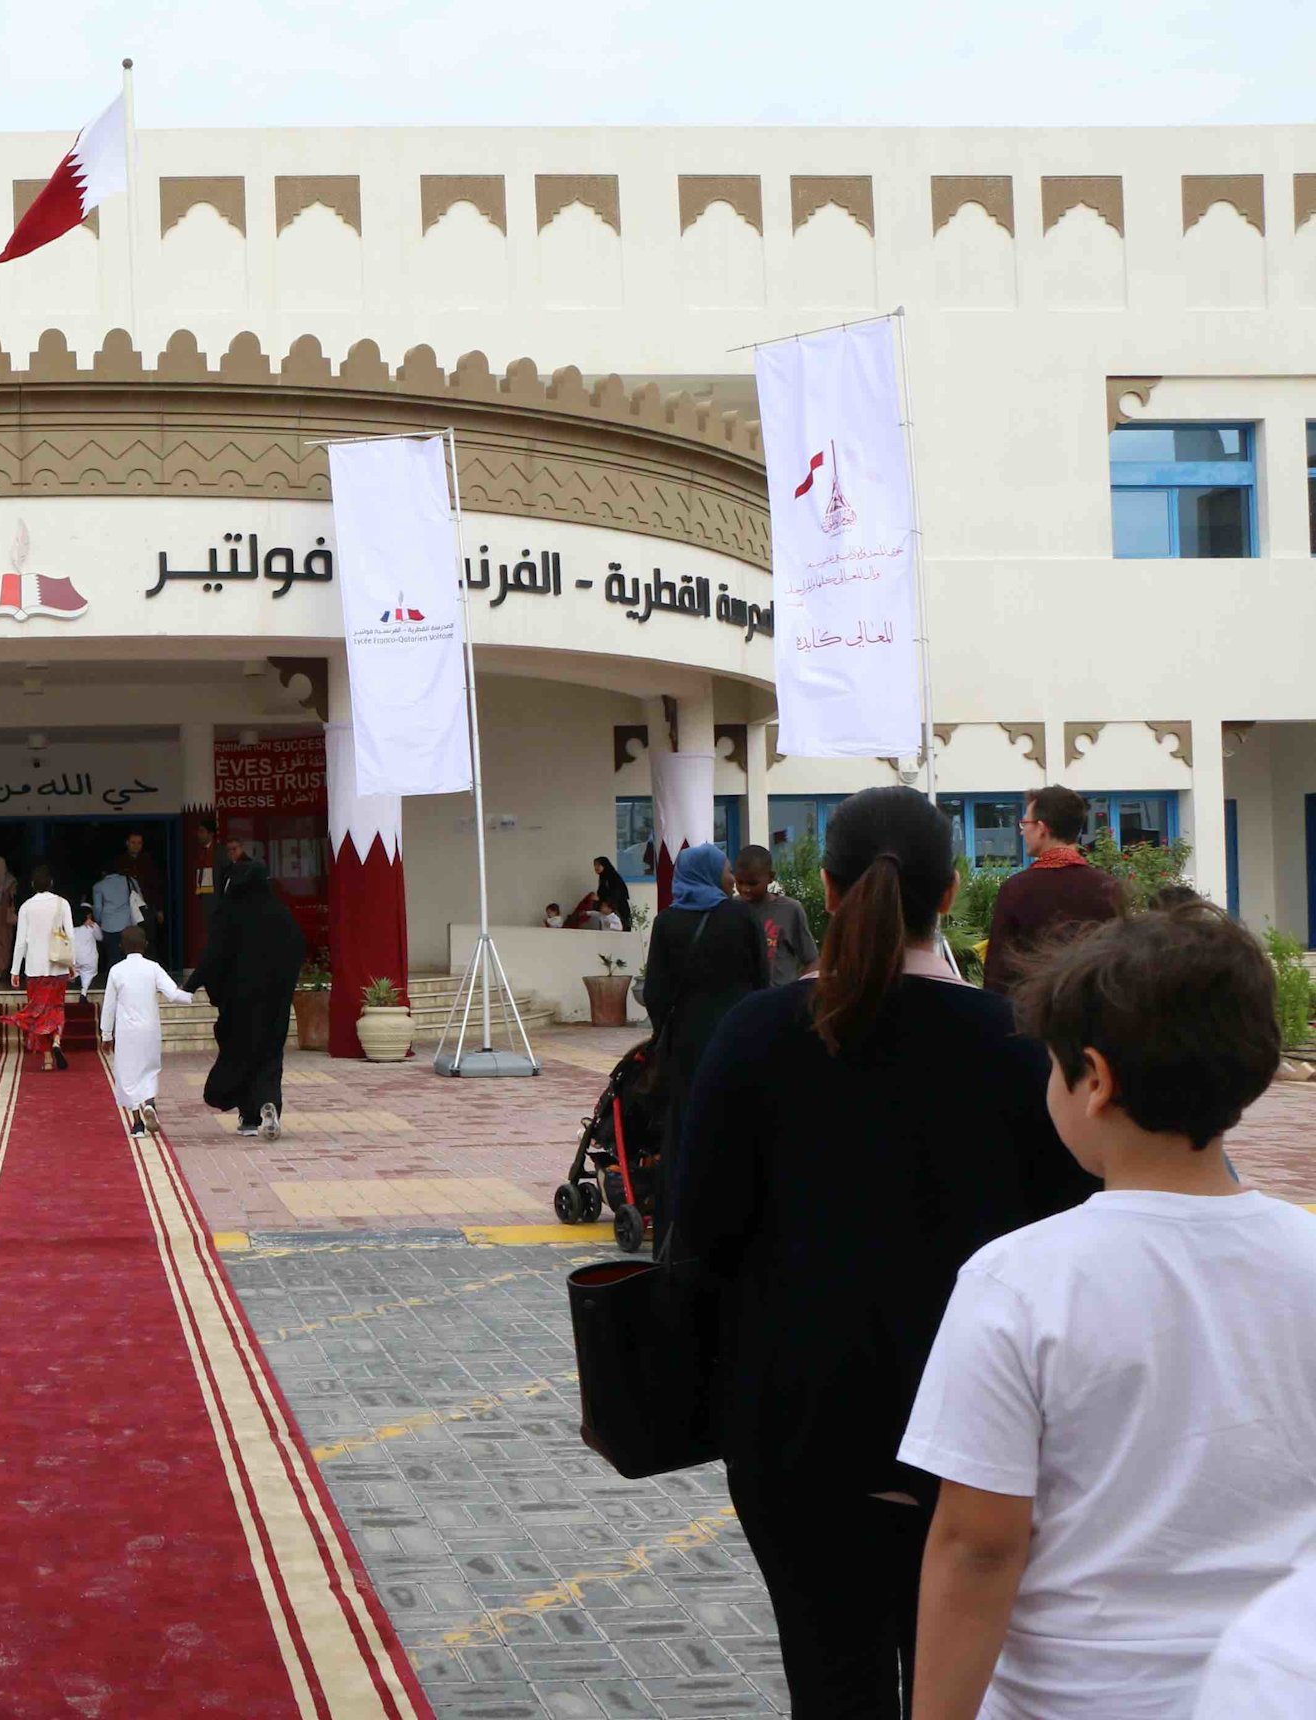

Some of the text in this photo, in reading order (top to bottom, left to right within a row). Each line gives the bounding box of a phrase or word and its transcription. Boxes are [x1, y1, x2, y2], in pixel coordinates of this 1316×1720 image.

[145, 532, 333, 600] فولتير
[605, 562, 711, 624] القطرية
[845, 620, 893, 648] المعالي
[36, 772, 92, 796] الله
[102, 778, 159, 811] حي
